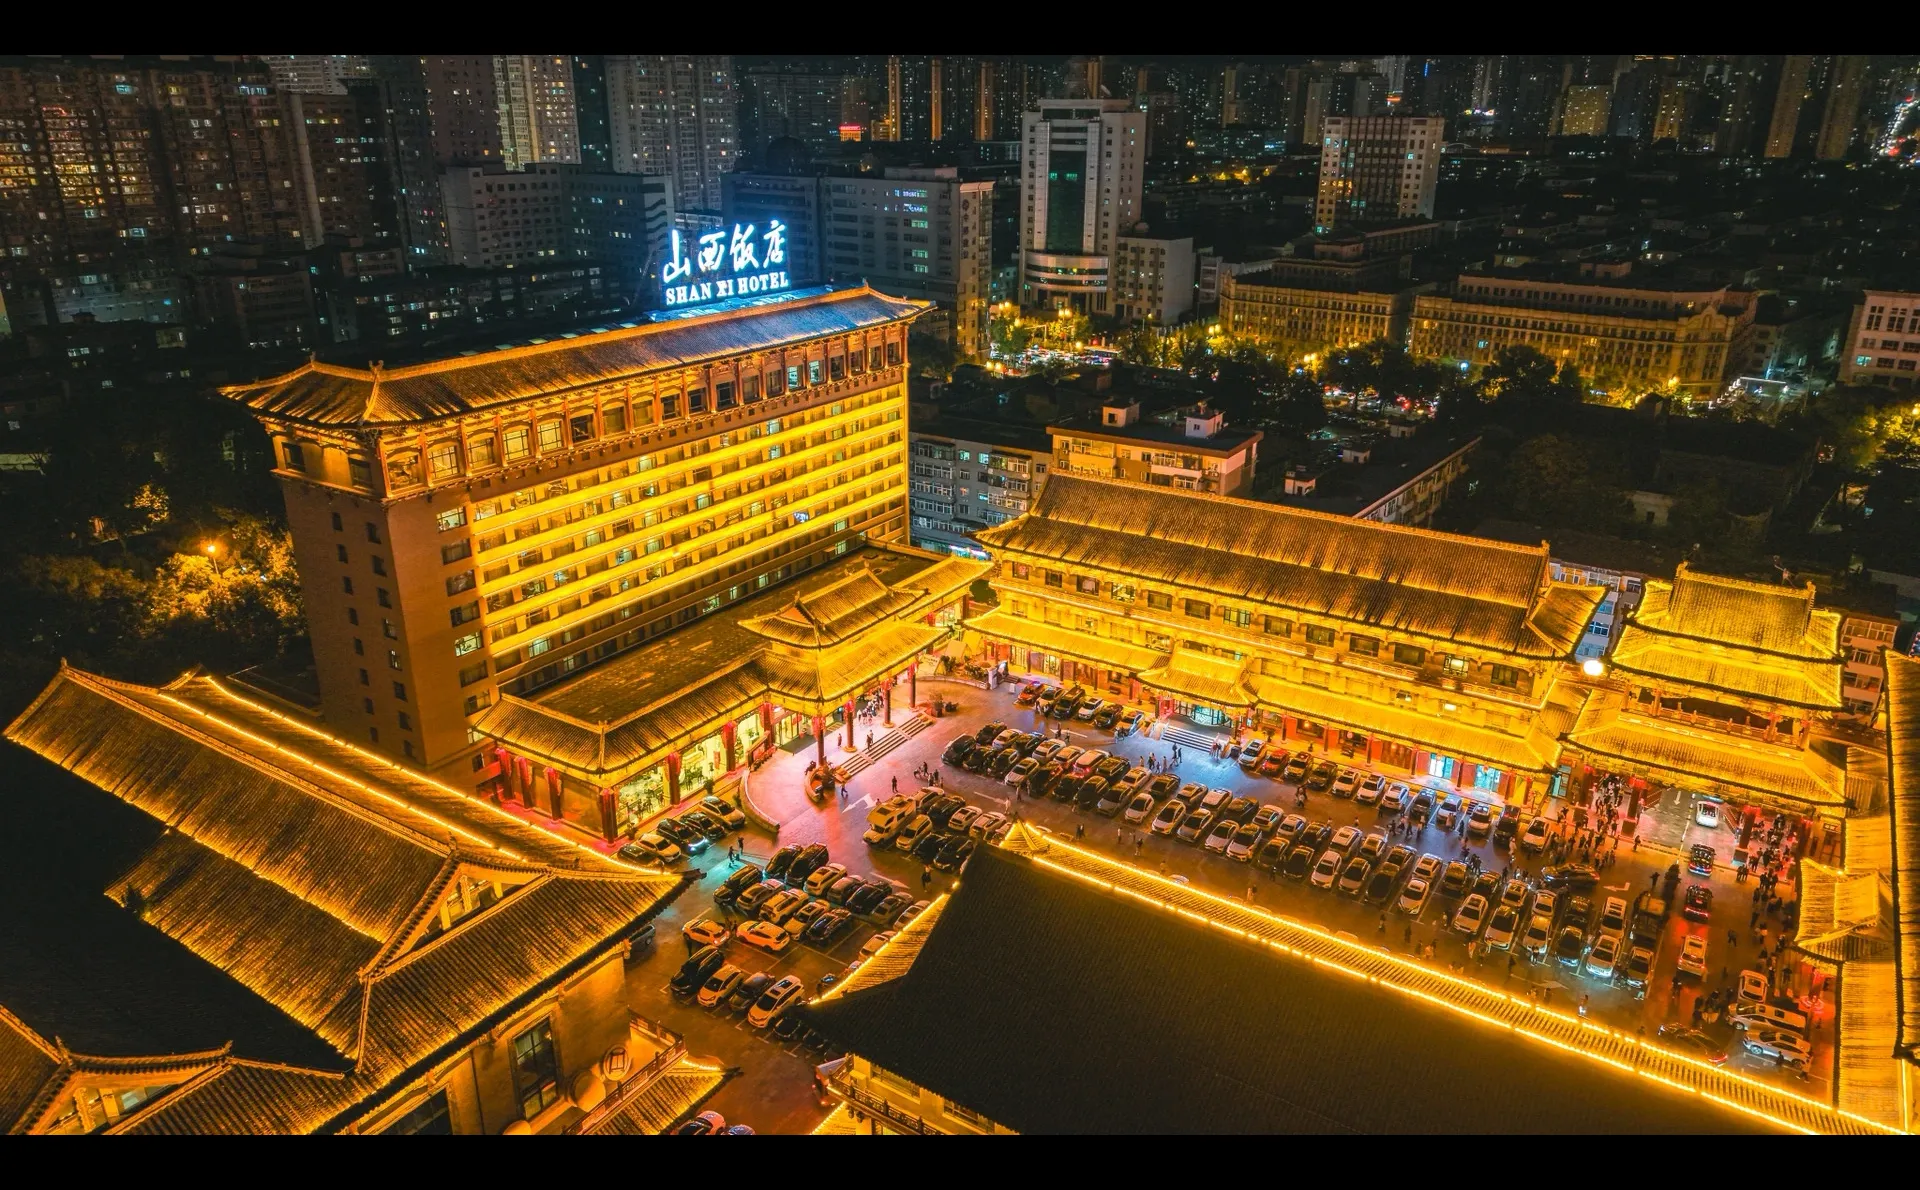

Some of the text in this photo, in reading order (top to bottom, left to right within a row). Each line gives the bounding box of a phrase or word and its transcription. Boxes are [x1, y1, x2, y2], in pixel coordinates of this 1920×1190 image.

[663, 219, 786, 283] 山西饭店
[666, 282, 712, 305] SHAN
[737, 271, 789, 295] HOTEL
